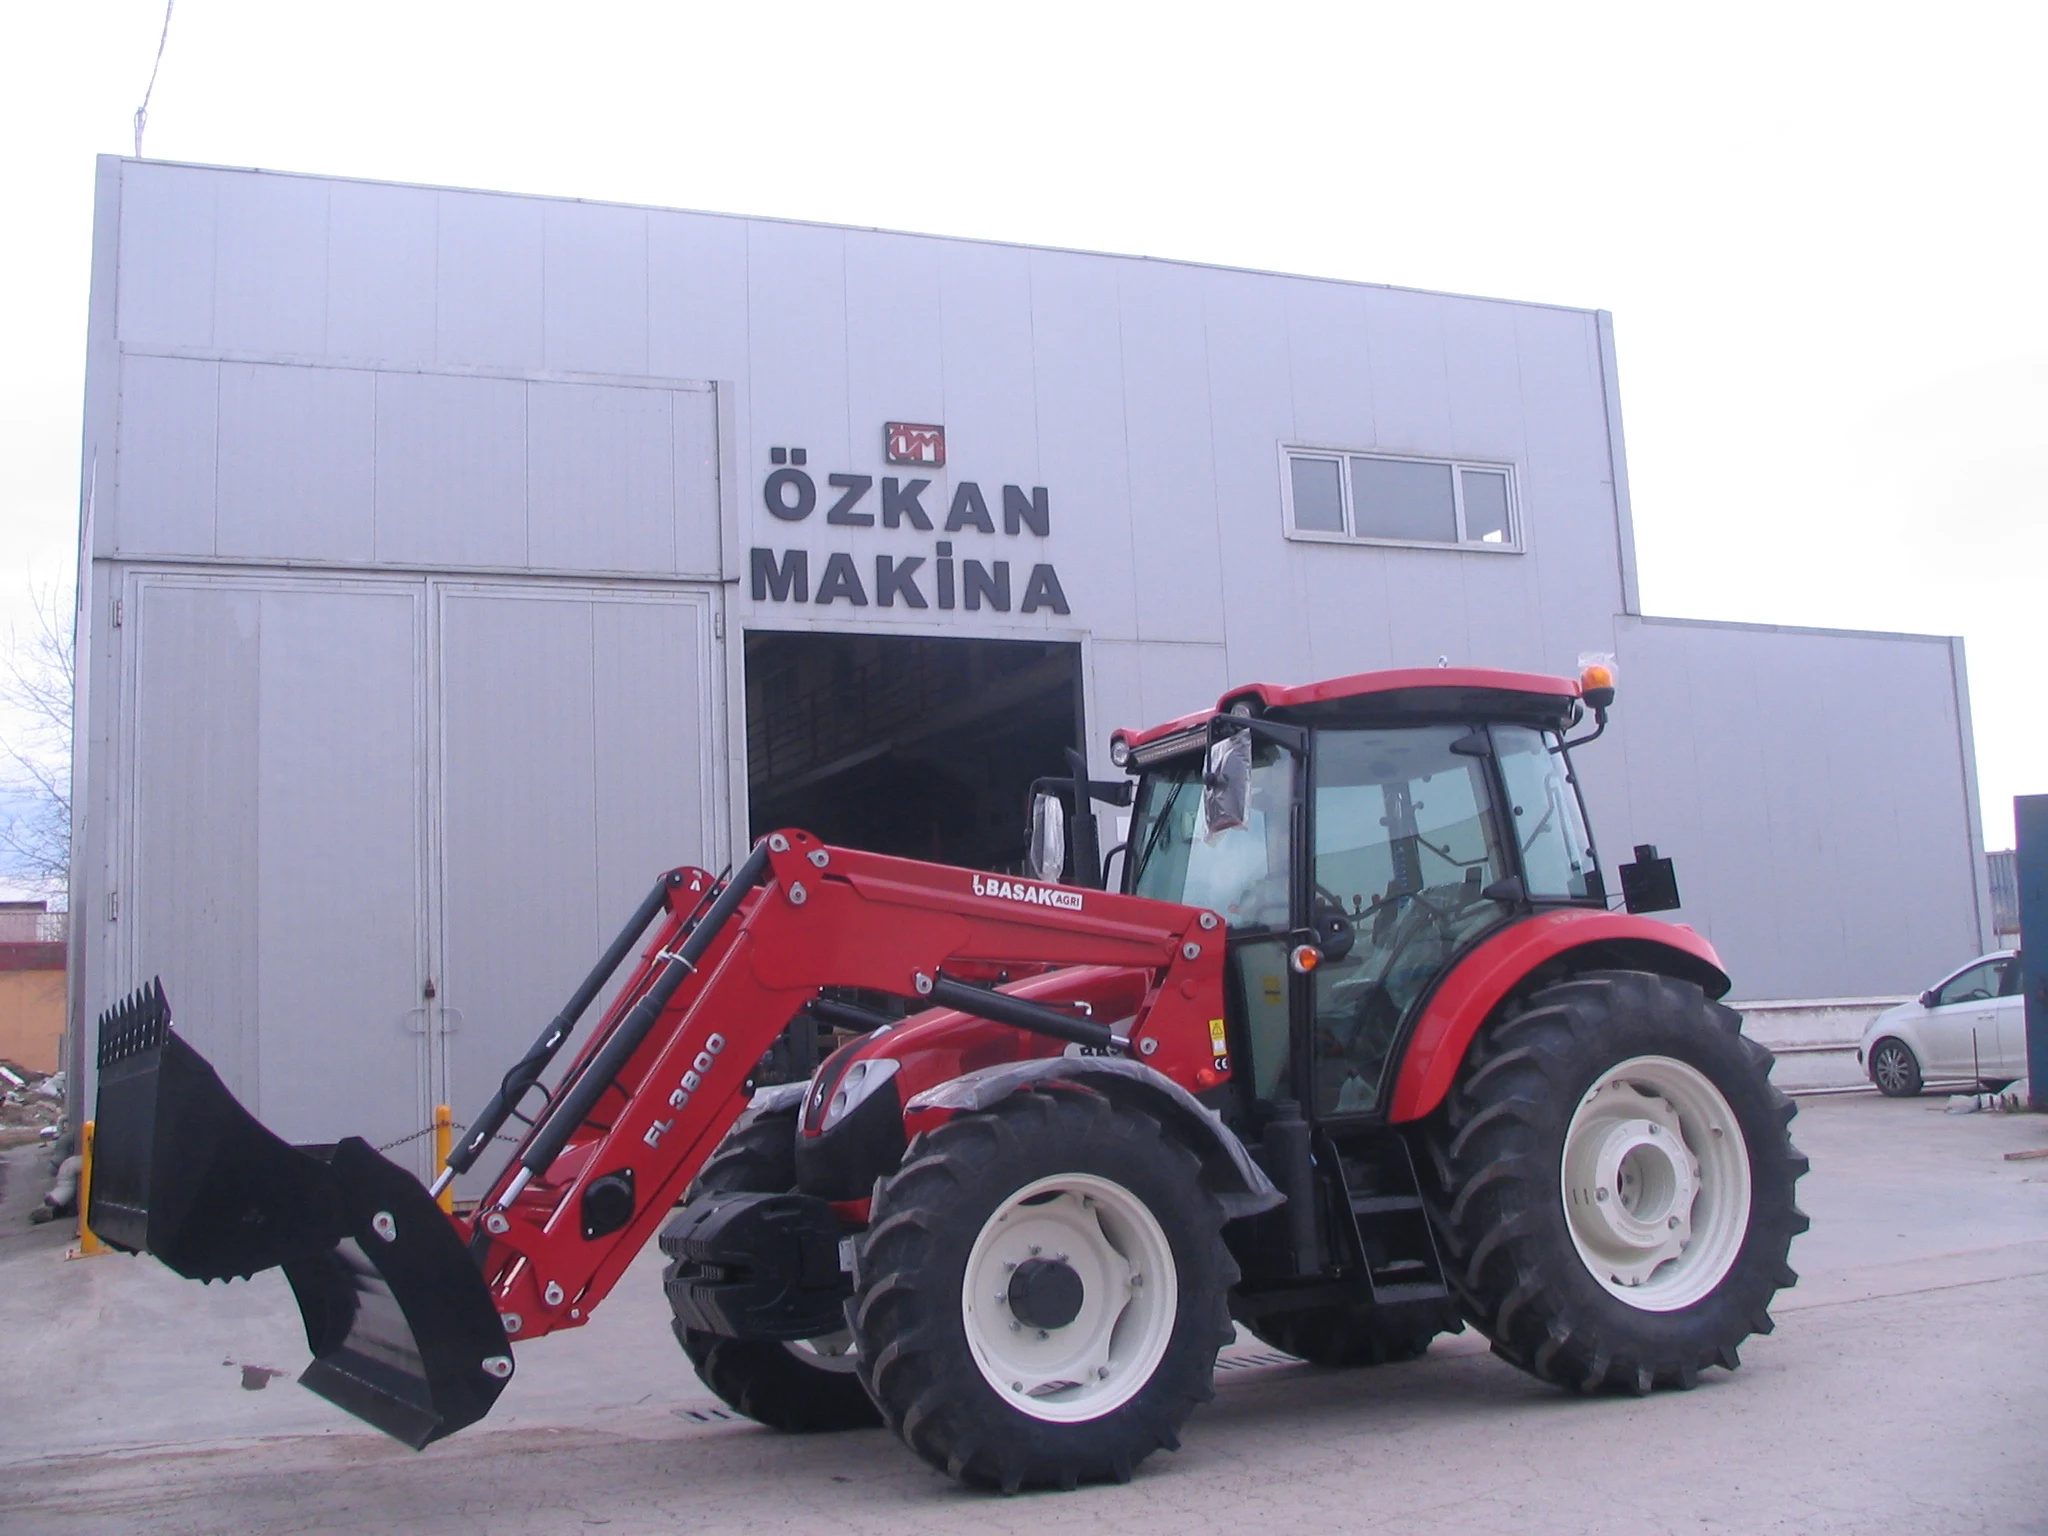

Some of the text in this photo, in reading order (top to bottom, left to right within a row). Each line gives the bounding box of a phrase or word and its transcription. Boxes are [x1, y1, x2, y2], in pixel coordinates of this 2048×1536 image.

[764, 447, 1050, 536] ÖZKAN
[751, 541, 1071, 614] MAKİNA
[986, 878, 1080, 907] BASAK AGRI
[643, 1032, 726, 1149] FL 3800
